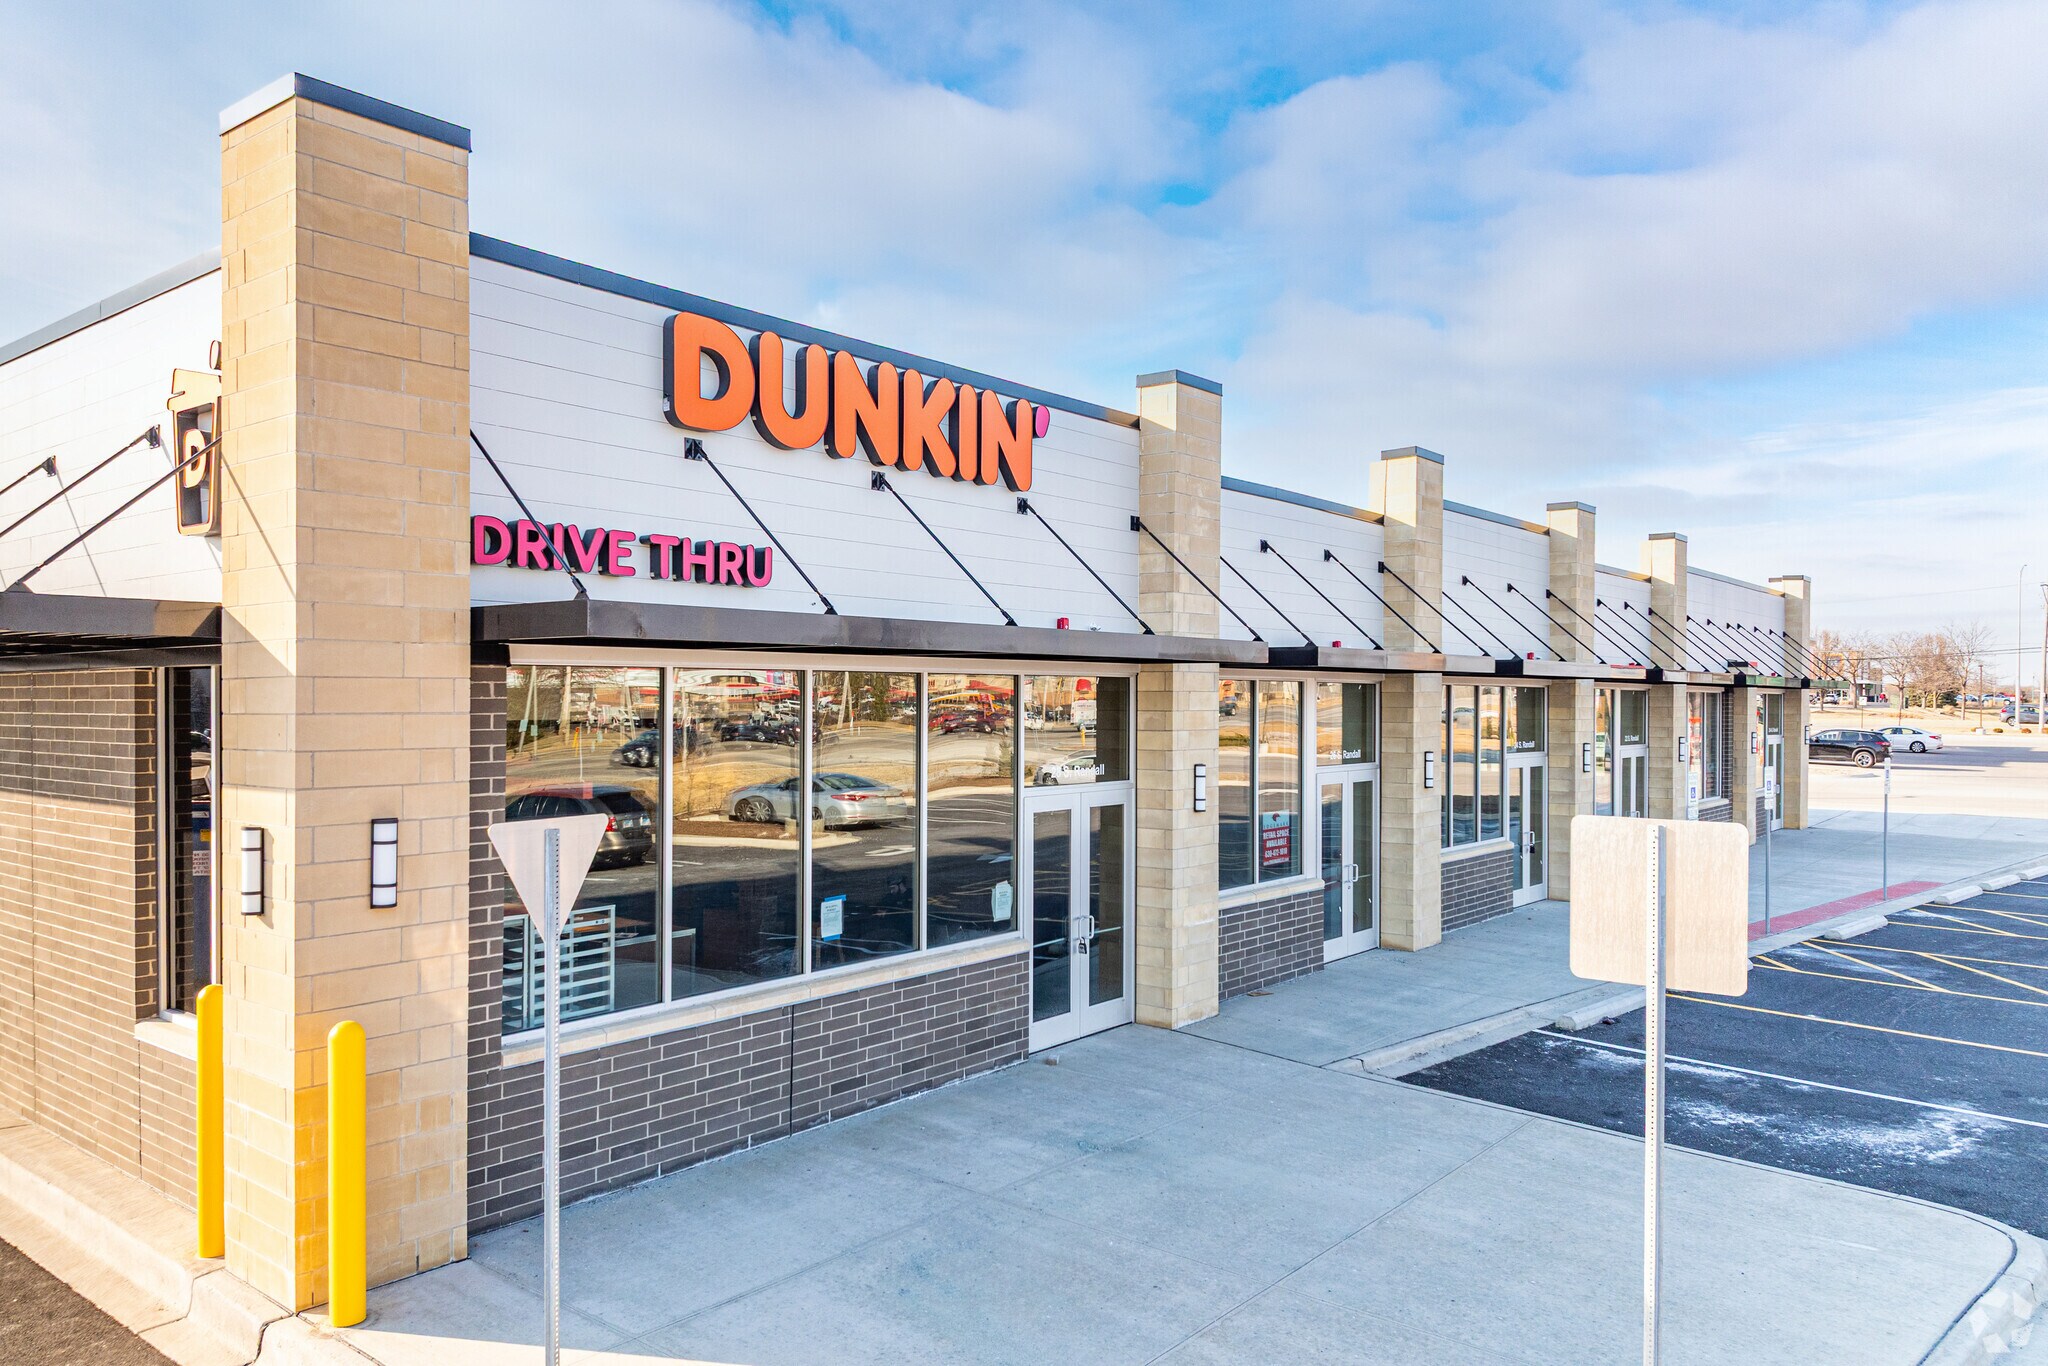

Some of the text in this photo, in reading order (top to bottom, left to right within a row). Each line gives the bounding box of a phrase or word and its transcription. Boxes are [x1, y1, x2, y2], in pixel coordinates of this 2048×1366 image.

[663, 312, 1050, 492] DUNKIN'
[184, 428, 207, 489] D
[473, 514, 773, 588] DRIVE THRU
[1343, 749, 1361, 759] Randall
[1074, 764, 1104, 776] Randall
[1263, 829, 1289, 840] RETAIL SPACE
[1267, 838, 1287, 848] AVAILABLE
